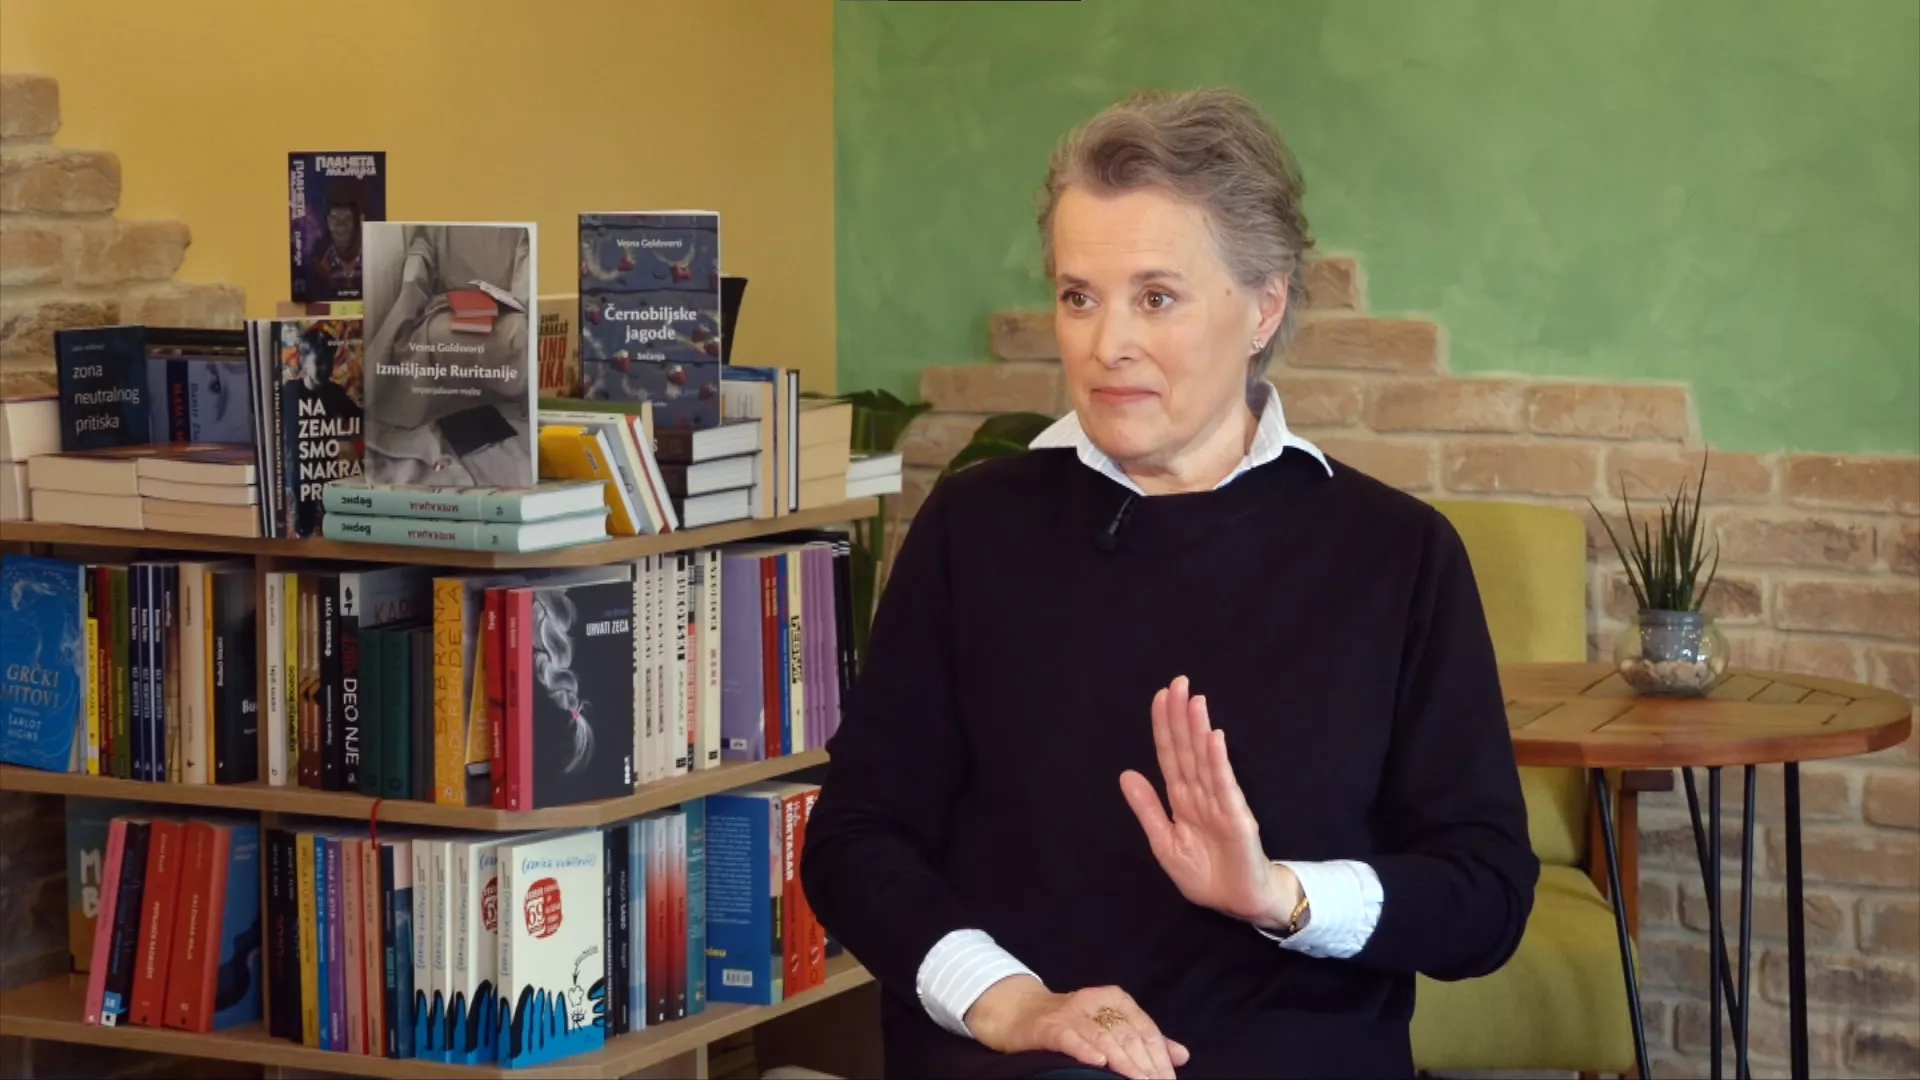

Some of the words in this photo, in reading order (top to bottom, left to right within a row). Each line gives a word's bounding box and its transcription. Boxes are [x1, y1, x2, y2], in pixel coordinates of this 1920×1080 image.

[617, 239, 640, 249] Vesna
[604, 303, 697, 325] Černobiljske
[625, 324, 676, 345] jagode
[408, 341, 435, 353] Vesna
[72, 364, 103, 379] zona
[375, 360, 448, 381] Izmišljanje
[450, 363, 518, 384] Ruritanije
[74, 386, 141, 405] neutralnog
[298, 397, 326, 418] NA
[75, 412, 120, 435] pritiska
[191, 422, 202, 441] Zla
[298, 416, 361, 438] ZEMLJI
[298, 438, 340, 461] SMO
[300, 482, 328, 503] PR
[447, 584, 464, 668] DELA
[586, 621, 611, 636] UHVATI
[611, 619, 629, 634] ZECA
[433, 585, 448, 736] SABRANA
[6, 660, 60, 688] GRČKI
[343, 677, 359, 722] DEO
[345, 727, 360, 765] NJE
[786, 802, 795, 881] KORTASAR
